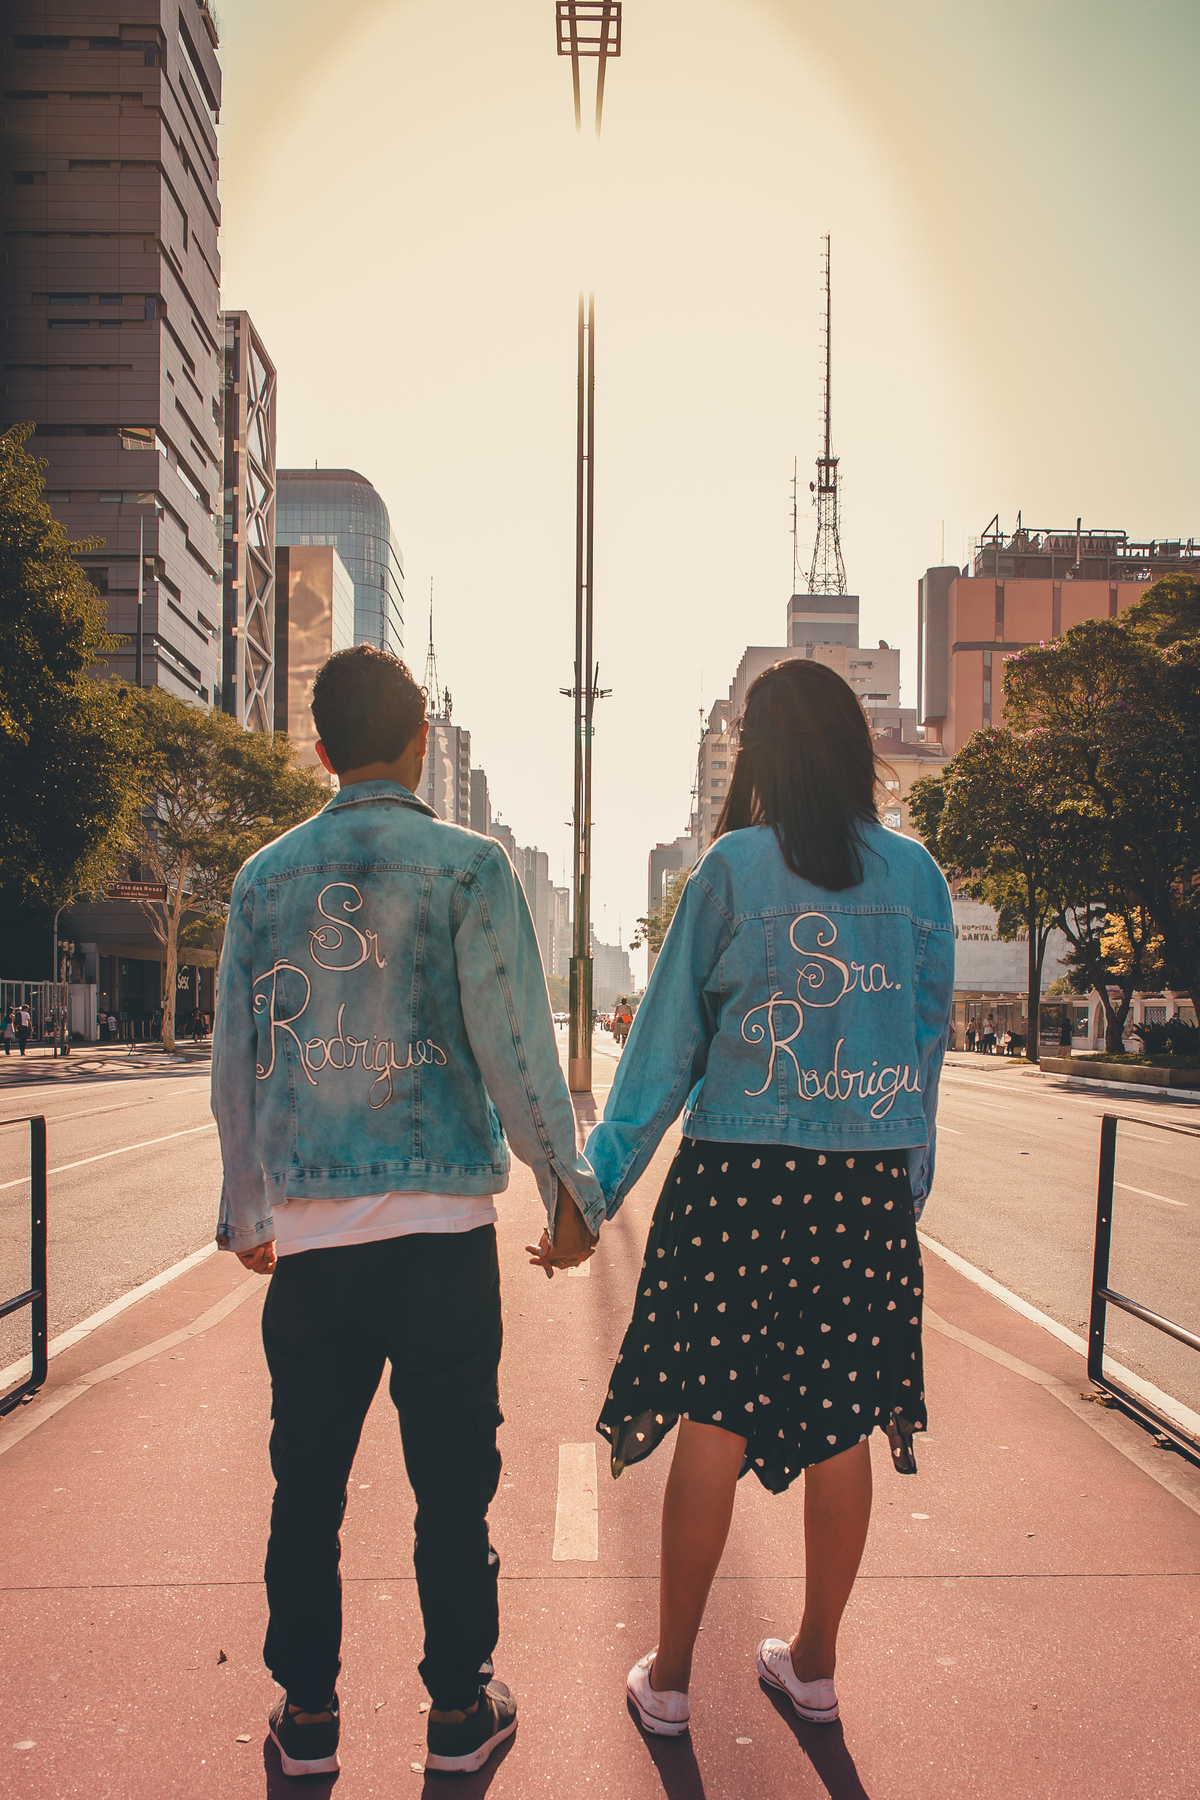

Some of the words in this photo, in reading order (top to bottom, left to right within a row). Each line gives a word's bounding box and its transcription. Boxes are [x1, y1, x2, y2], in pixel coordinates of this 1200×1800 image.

[789, 911, 902, 1008] Sra.
[962, 932, 990, 941] SANTA
[252, 958, 448, 1110] Rodrigues
